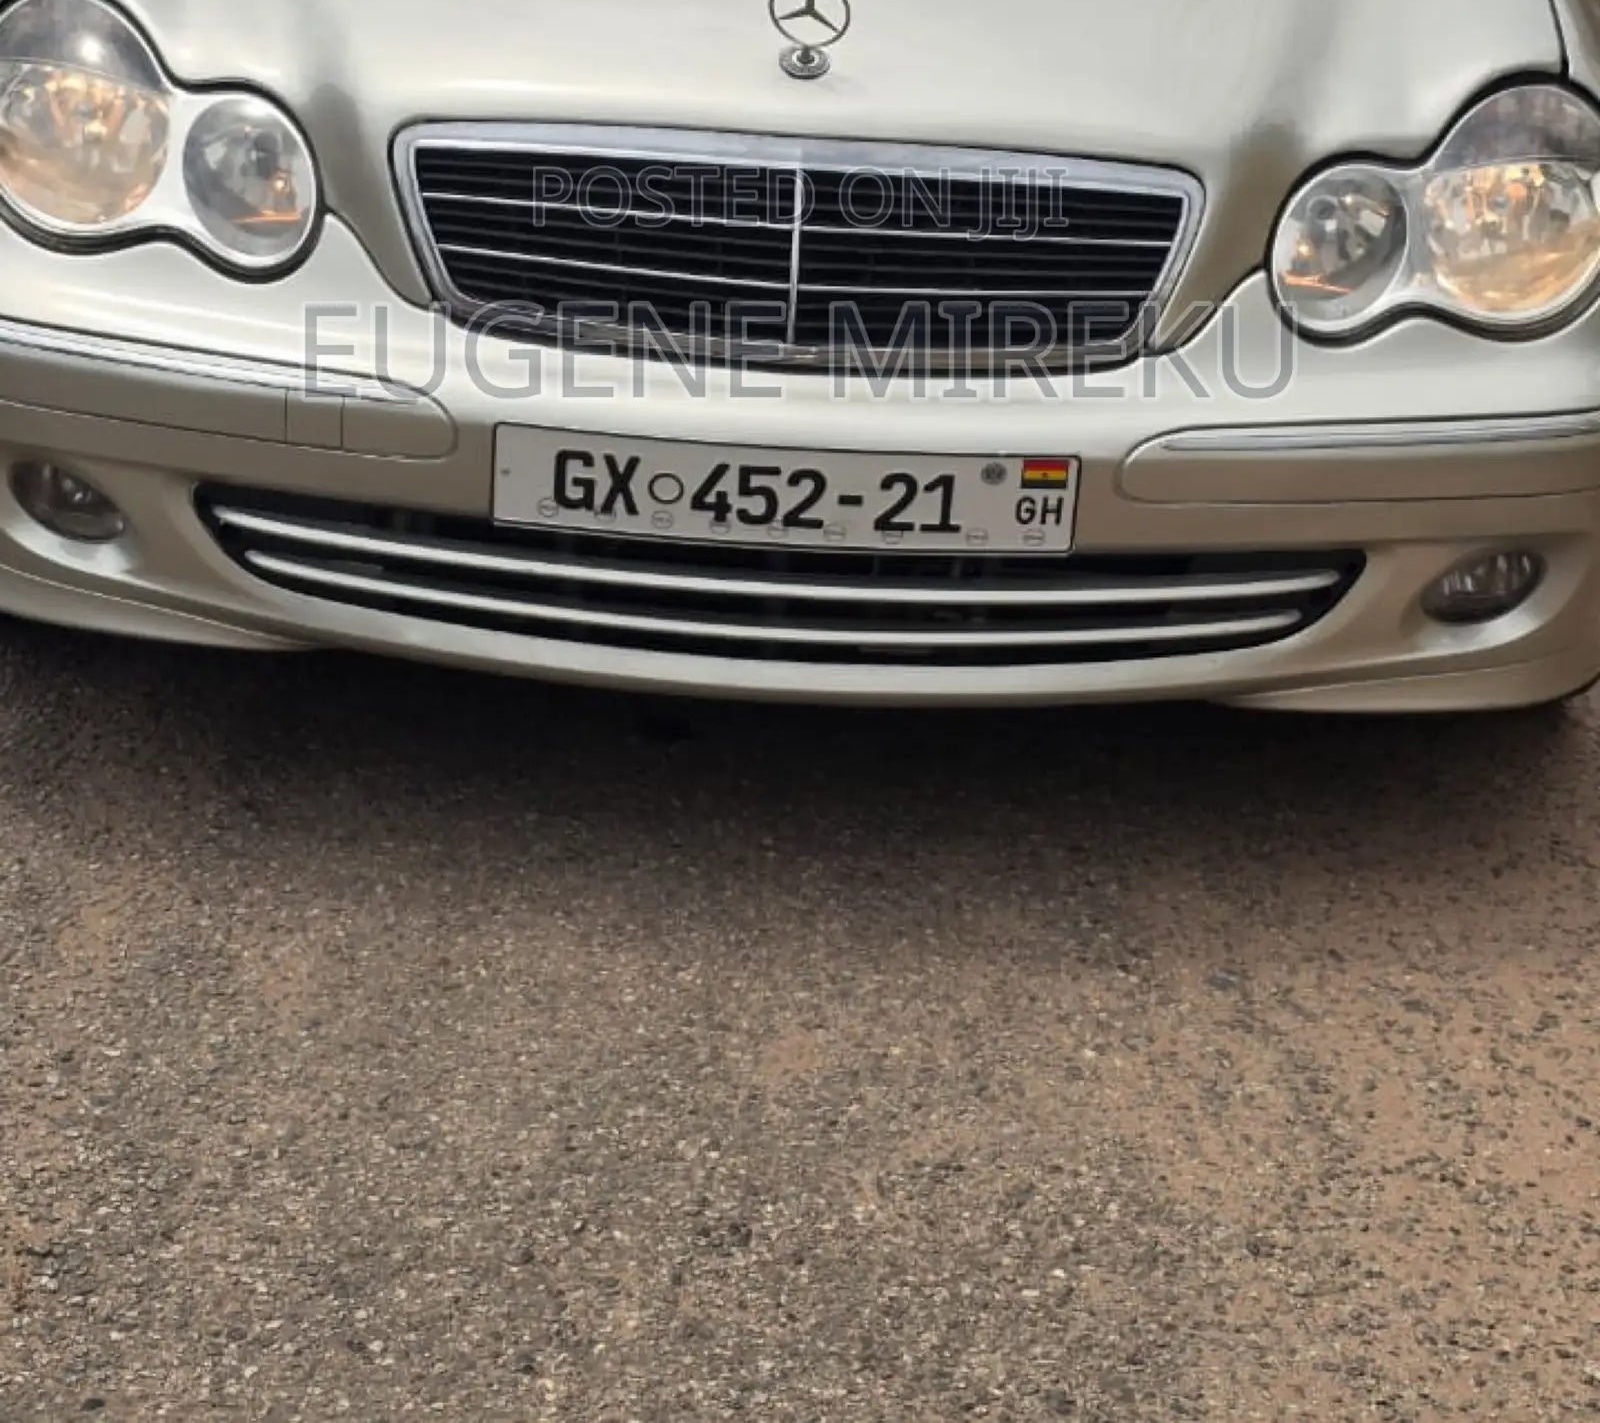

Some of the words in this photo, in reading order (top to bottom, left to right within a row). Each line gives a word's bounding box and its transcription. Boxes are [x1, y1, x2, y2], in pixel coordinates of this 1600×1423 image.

[554, 448, 642, 516] GX
[690, 461, 962, 533] 452-21
[1014, 495, 1064, 526] GH
